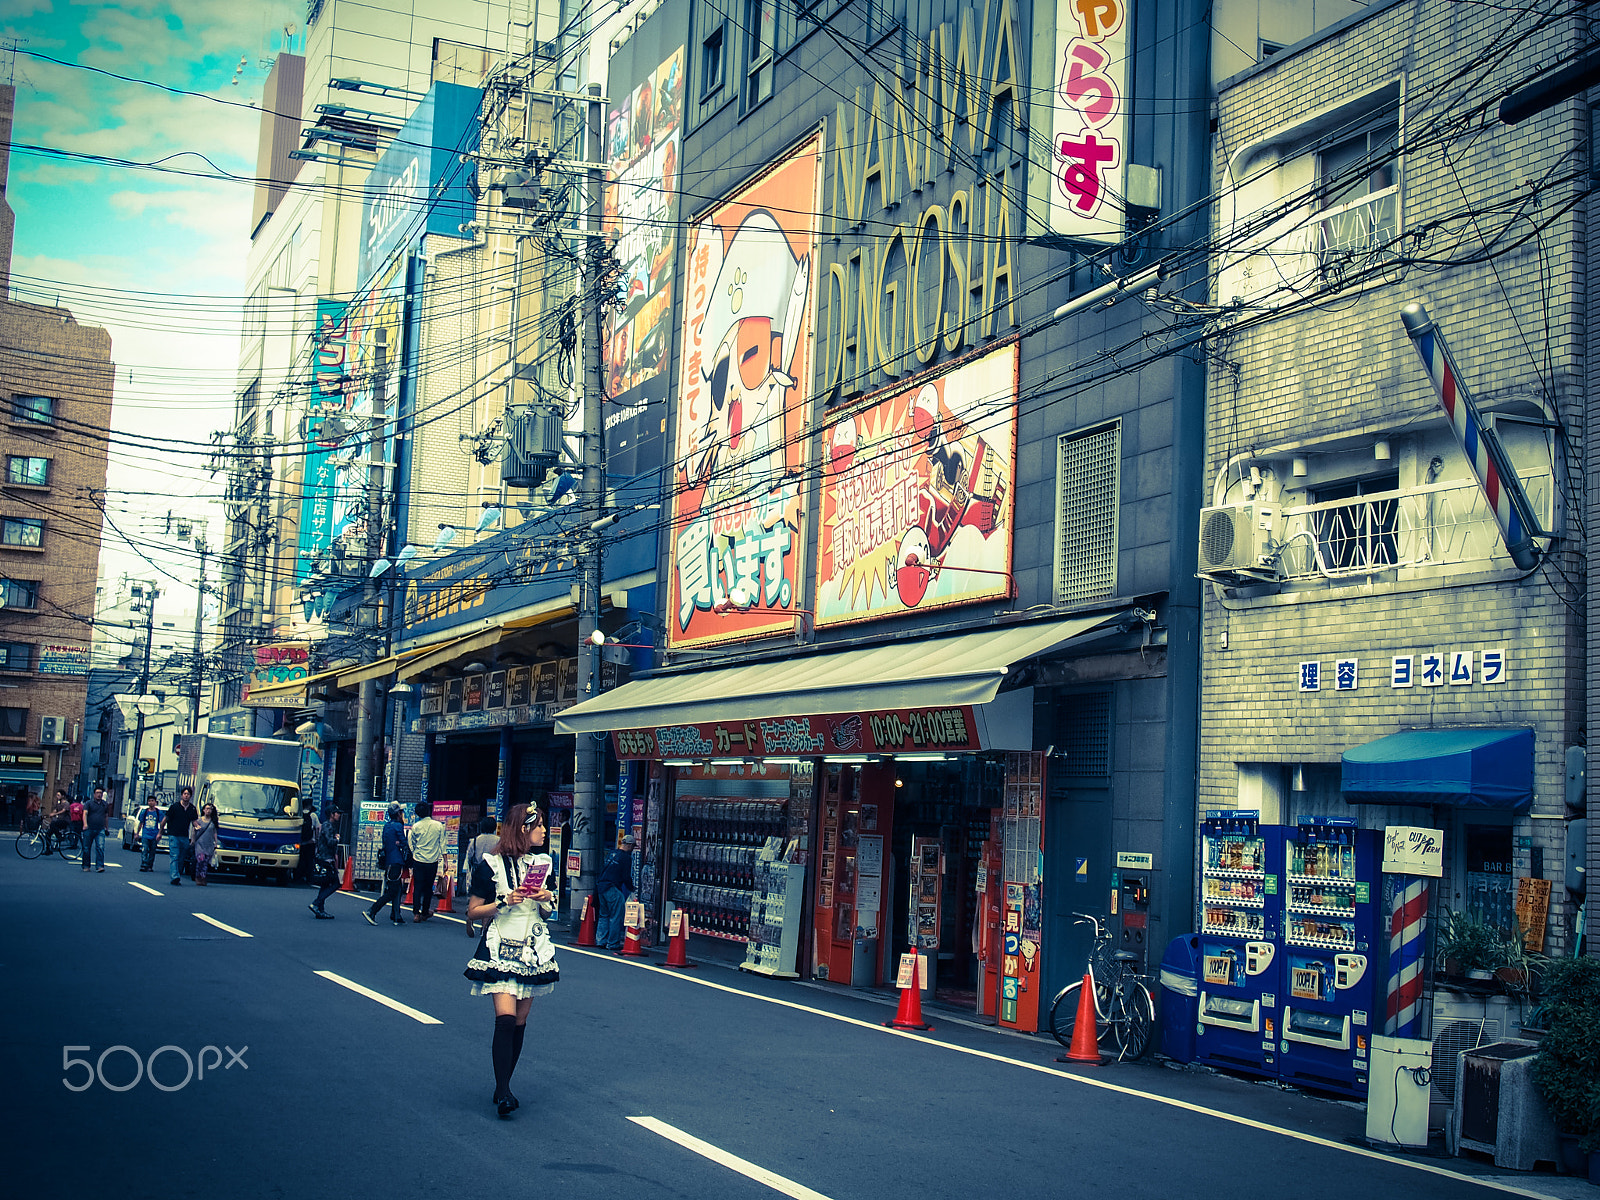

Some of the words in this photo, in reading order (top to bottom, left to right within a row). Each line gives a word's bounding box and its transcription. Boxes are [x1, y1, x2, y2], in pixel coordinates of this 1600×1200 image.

[831, 0, 1024, 241] NANIWA
[369, 156, 419, 248] Sofmap
[824, 163, 1023, 404] DENGYOSHA
[686, 243, 710, 422] 持ってきて
[678, 520, 791, 632] 買います。
[1301, 662, 1355, 689] 理容
[1394, 653, 1502, 684] ヨネムラ
[617, 731, 655, 755] おもちゃ
[715, 722, 757, 753] カード
[760, 718, 810, 737] アーケードカード
[764, 733, 825, 753] トレーディングカード
[238, 758, 264, 767] SEINO
[618, 778, 628, 828] ソフマップに
[1409, 831, 1421, 843] CUT
[1483, 861, 1503, 872] BAR
[1517, 893, 1544, 905] フルコース
[1004, 911, 1019, 1020] 見つかる!
